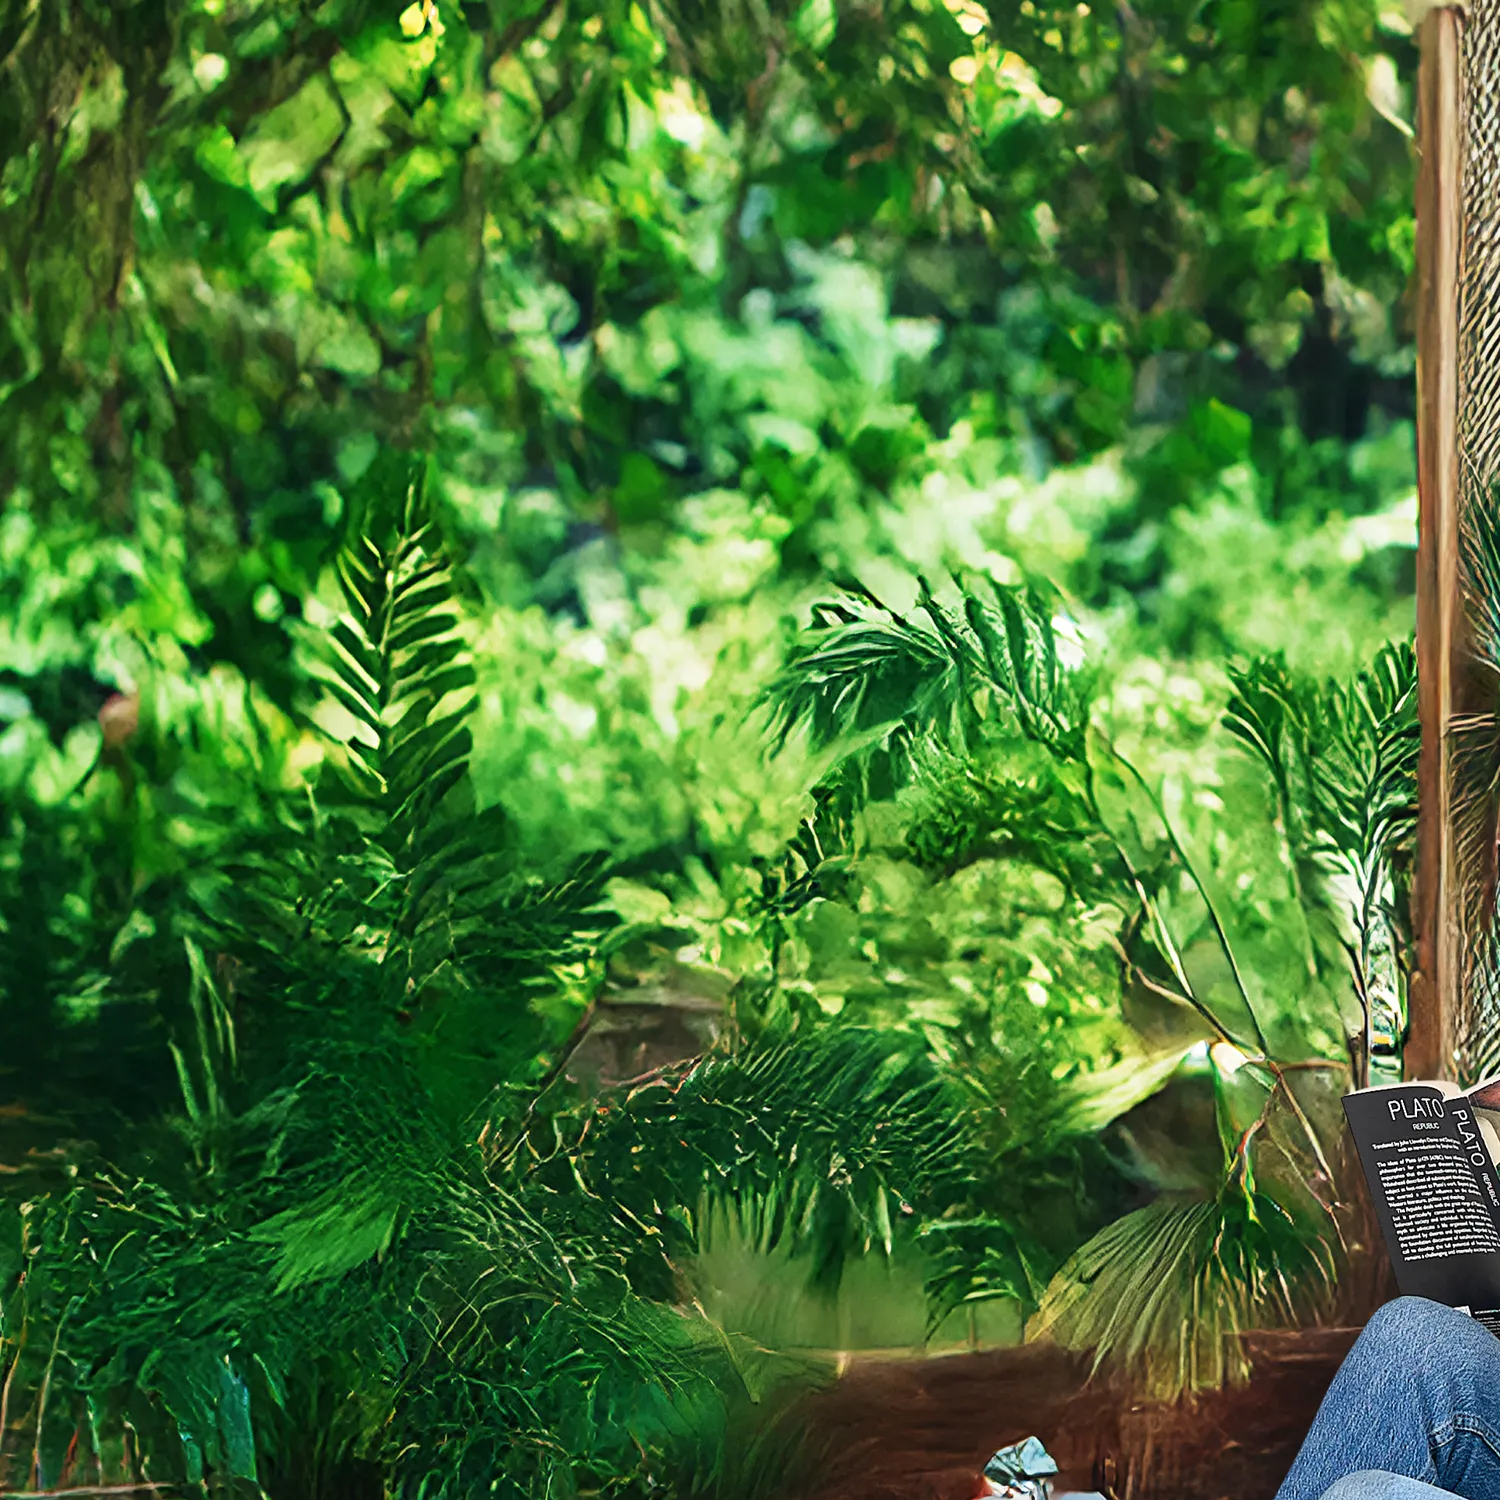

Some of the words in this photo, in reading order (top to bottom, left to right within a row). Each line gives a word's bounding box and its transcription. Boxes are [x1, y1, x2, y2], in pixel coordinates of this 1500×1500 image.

[1387, 1097, 1445, 1121] PLATO
[1412, 1122, 1440, 1130] REPUBLIC
[1452, 1109, 1486, 1167] PLATO
[1481, 1172, 1500, 1208] REPUBLIC
